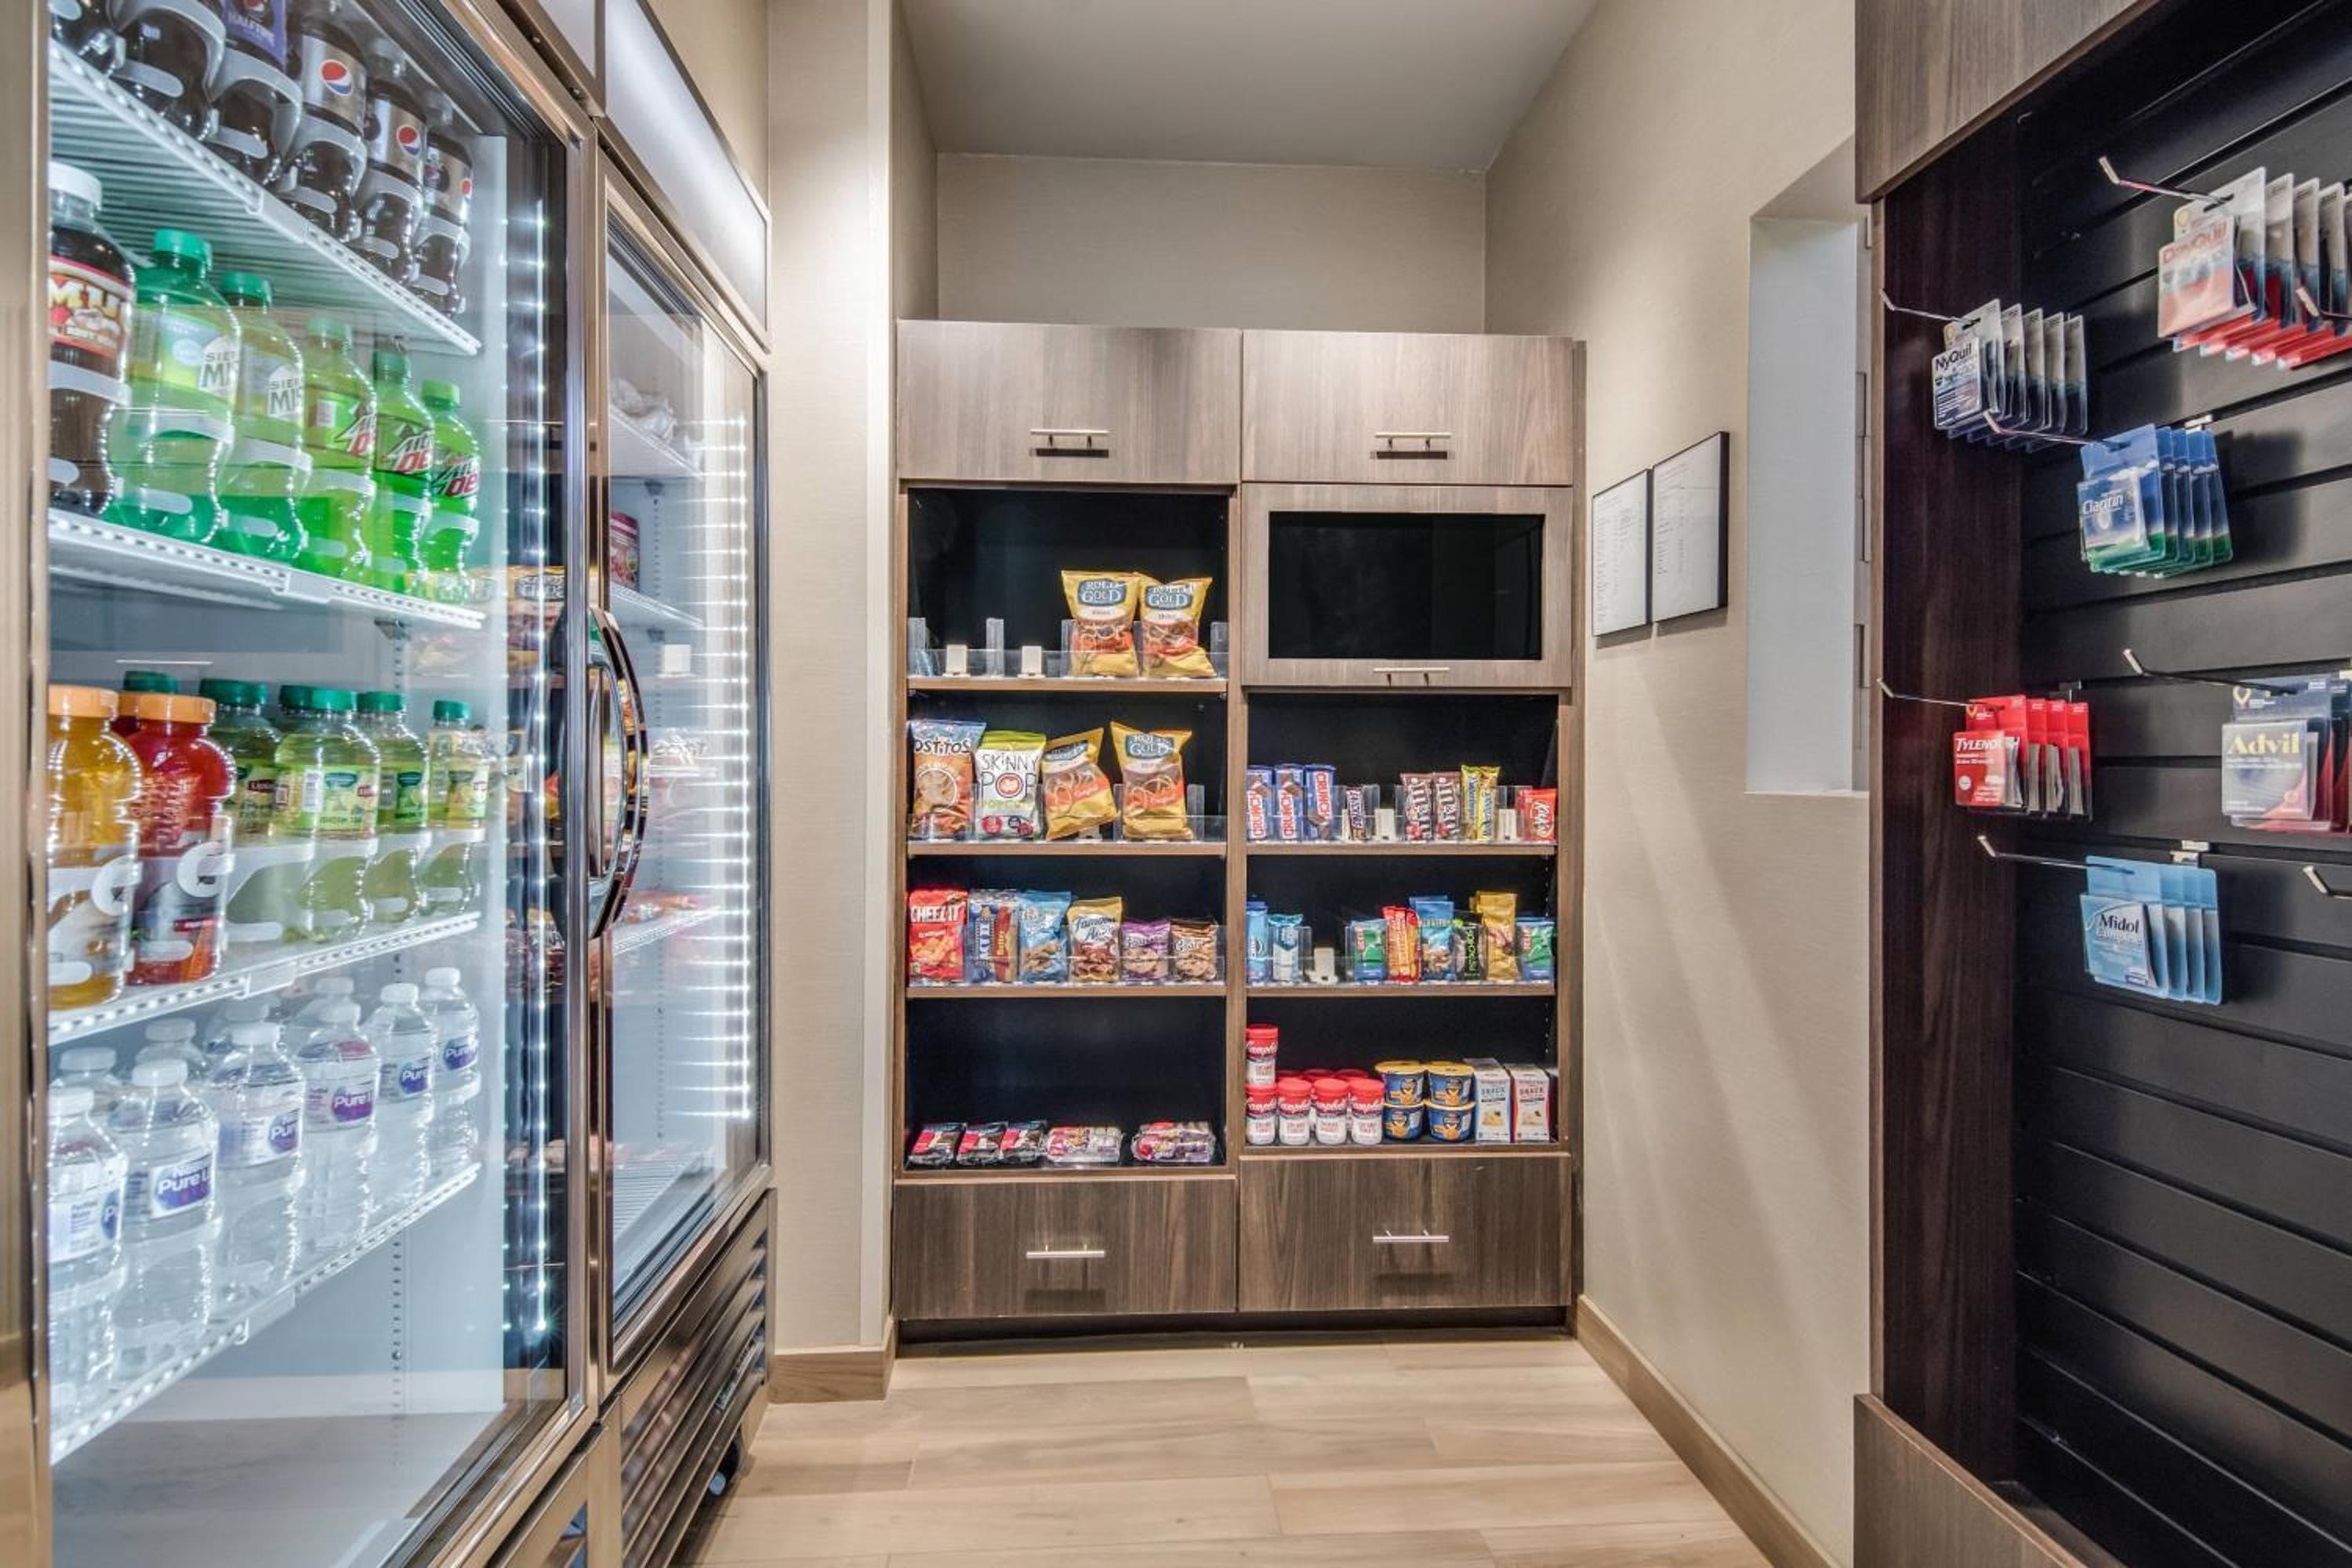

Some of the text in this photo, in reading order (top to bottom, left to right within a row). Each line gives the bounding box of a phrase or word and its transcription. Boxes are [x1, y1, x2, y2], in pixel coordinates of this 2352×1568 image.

[1935, 343, 1972, 372] NyQuil
[2082, 492, 2124, 517] Claritin
[1080, 589, 1122, 604] GOLD
[1147, 593, 1189, 608] GOLD
[1955, 738, 2003, 753] TYLENOL
[2227, 731, 2299, 755] Advil
[982, 753, 1036, 771] SKINNY
[1316, 772, 1330, 818] CRUNCH
[1280, 791, 1294, 837] CRUNCH
[2098, 913, 2140, 935] Midol
[158, 1172, 201, 1196] Pure
